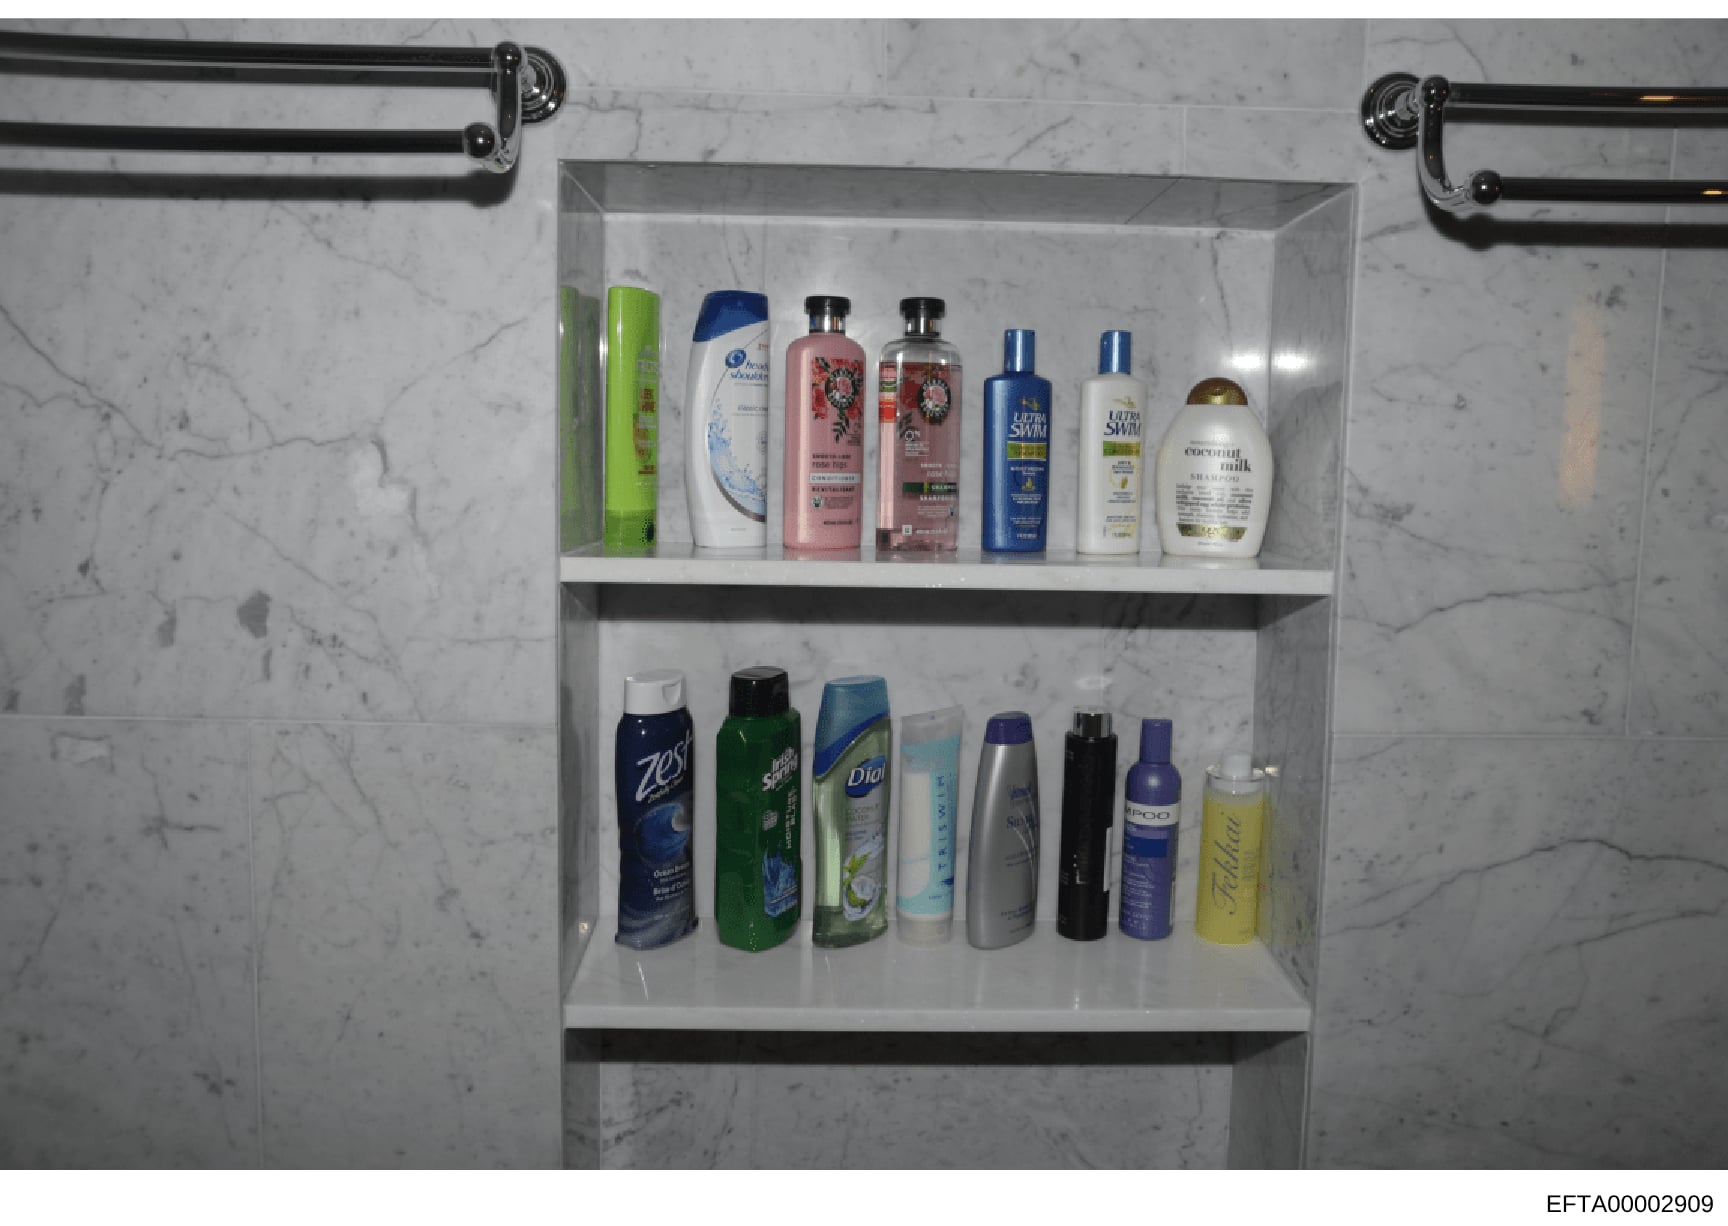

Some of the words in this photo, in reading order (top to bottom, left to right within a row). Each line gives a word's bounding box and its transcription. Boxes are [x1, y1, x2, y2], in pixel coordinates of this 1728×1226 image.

[1013, 411, 1048, 423] ULTRA
[1108, 409, 1141, 422] ULTRA
[1008, 422, 1048, 439] SWIM
[1103, 421, 1142, 437] SWIM
[1184, 447, 1242, 459] coconut
[1219, 458, 1252, 472] milk
[1189, 472, 1241, 483] SHAMPOO
[772, 747, 795, 773] Irish
[761, 753, 798, 792] Spring
[847, 761, 886, 787] Dial
[937, 775, 948, 872] TRISWIM
[1210, 811, 1241, 916] Fekkai
